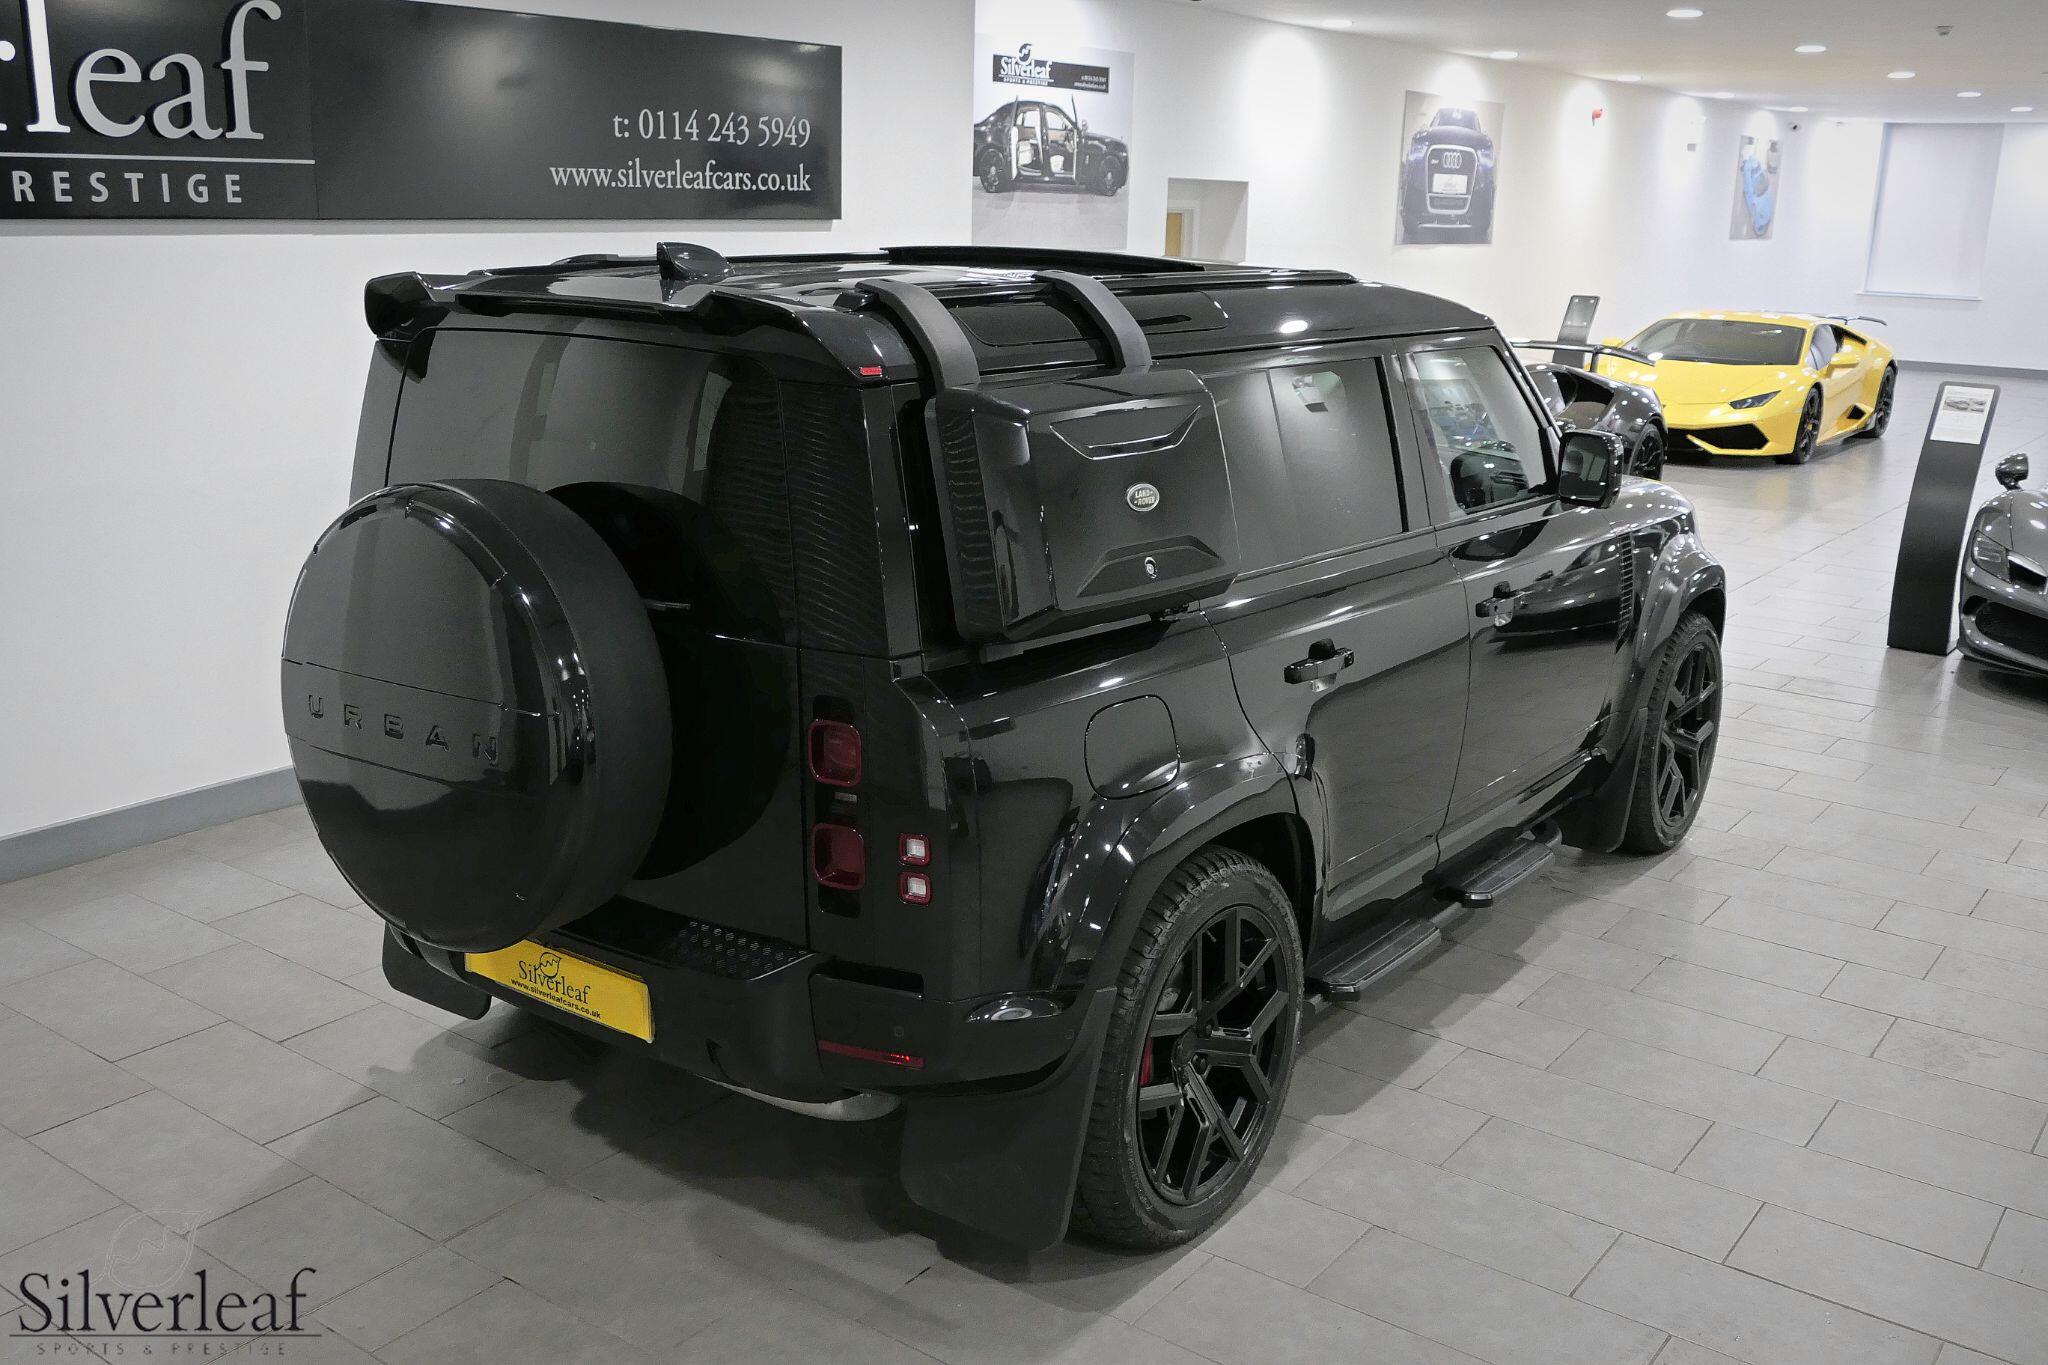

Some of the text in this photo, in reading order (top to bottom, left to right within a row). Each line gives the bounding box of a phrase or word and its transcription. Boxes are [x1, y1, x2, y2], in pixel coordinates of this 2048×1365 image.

[0, 0, 282, 140] leaf
[1000, 56, 1053, 79] Silverleaf
[613, 108, 811, 148] t: 0114 243 5949
[549, 157, 812, 192] www.silverleafcars.co.uk
[1135, 489, 1151, 499] LAND
[308, 694, 499, 768] URBAN
[510, 977, 602, 1020] www.silverleafcars.co.uk
[518, 959, 592, 1005] Silverleaf
